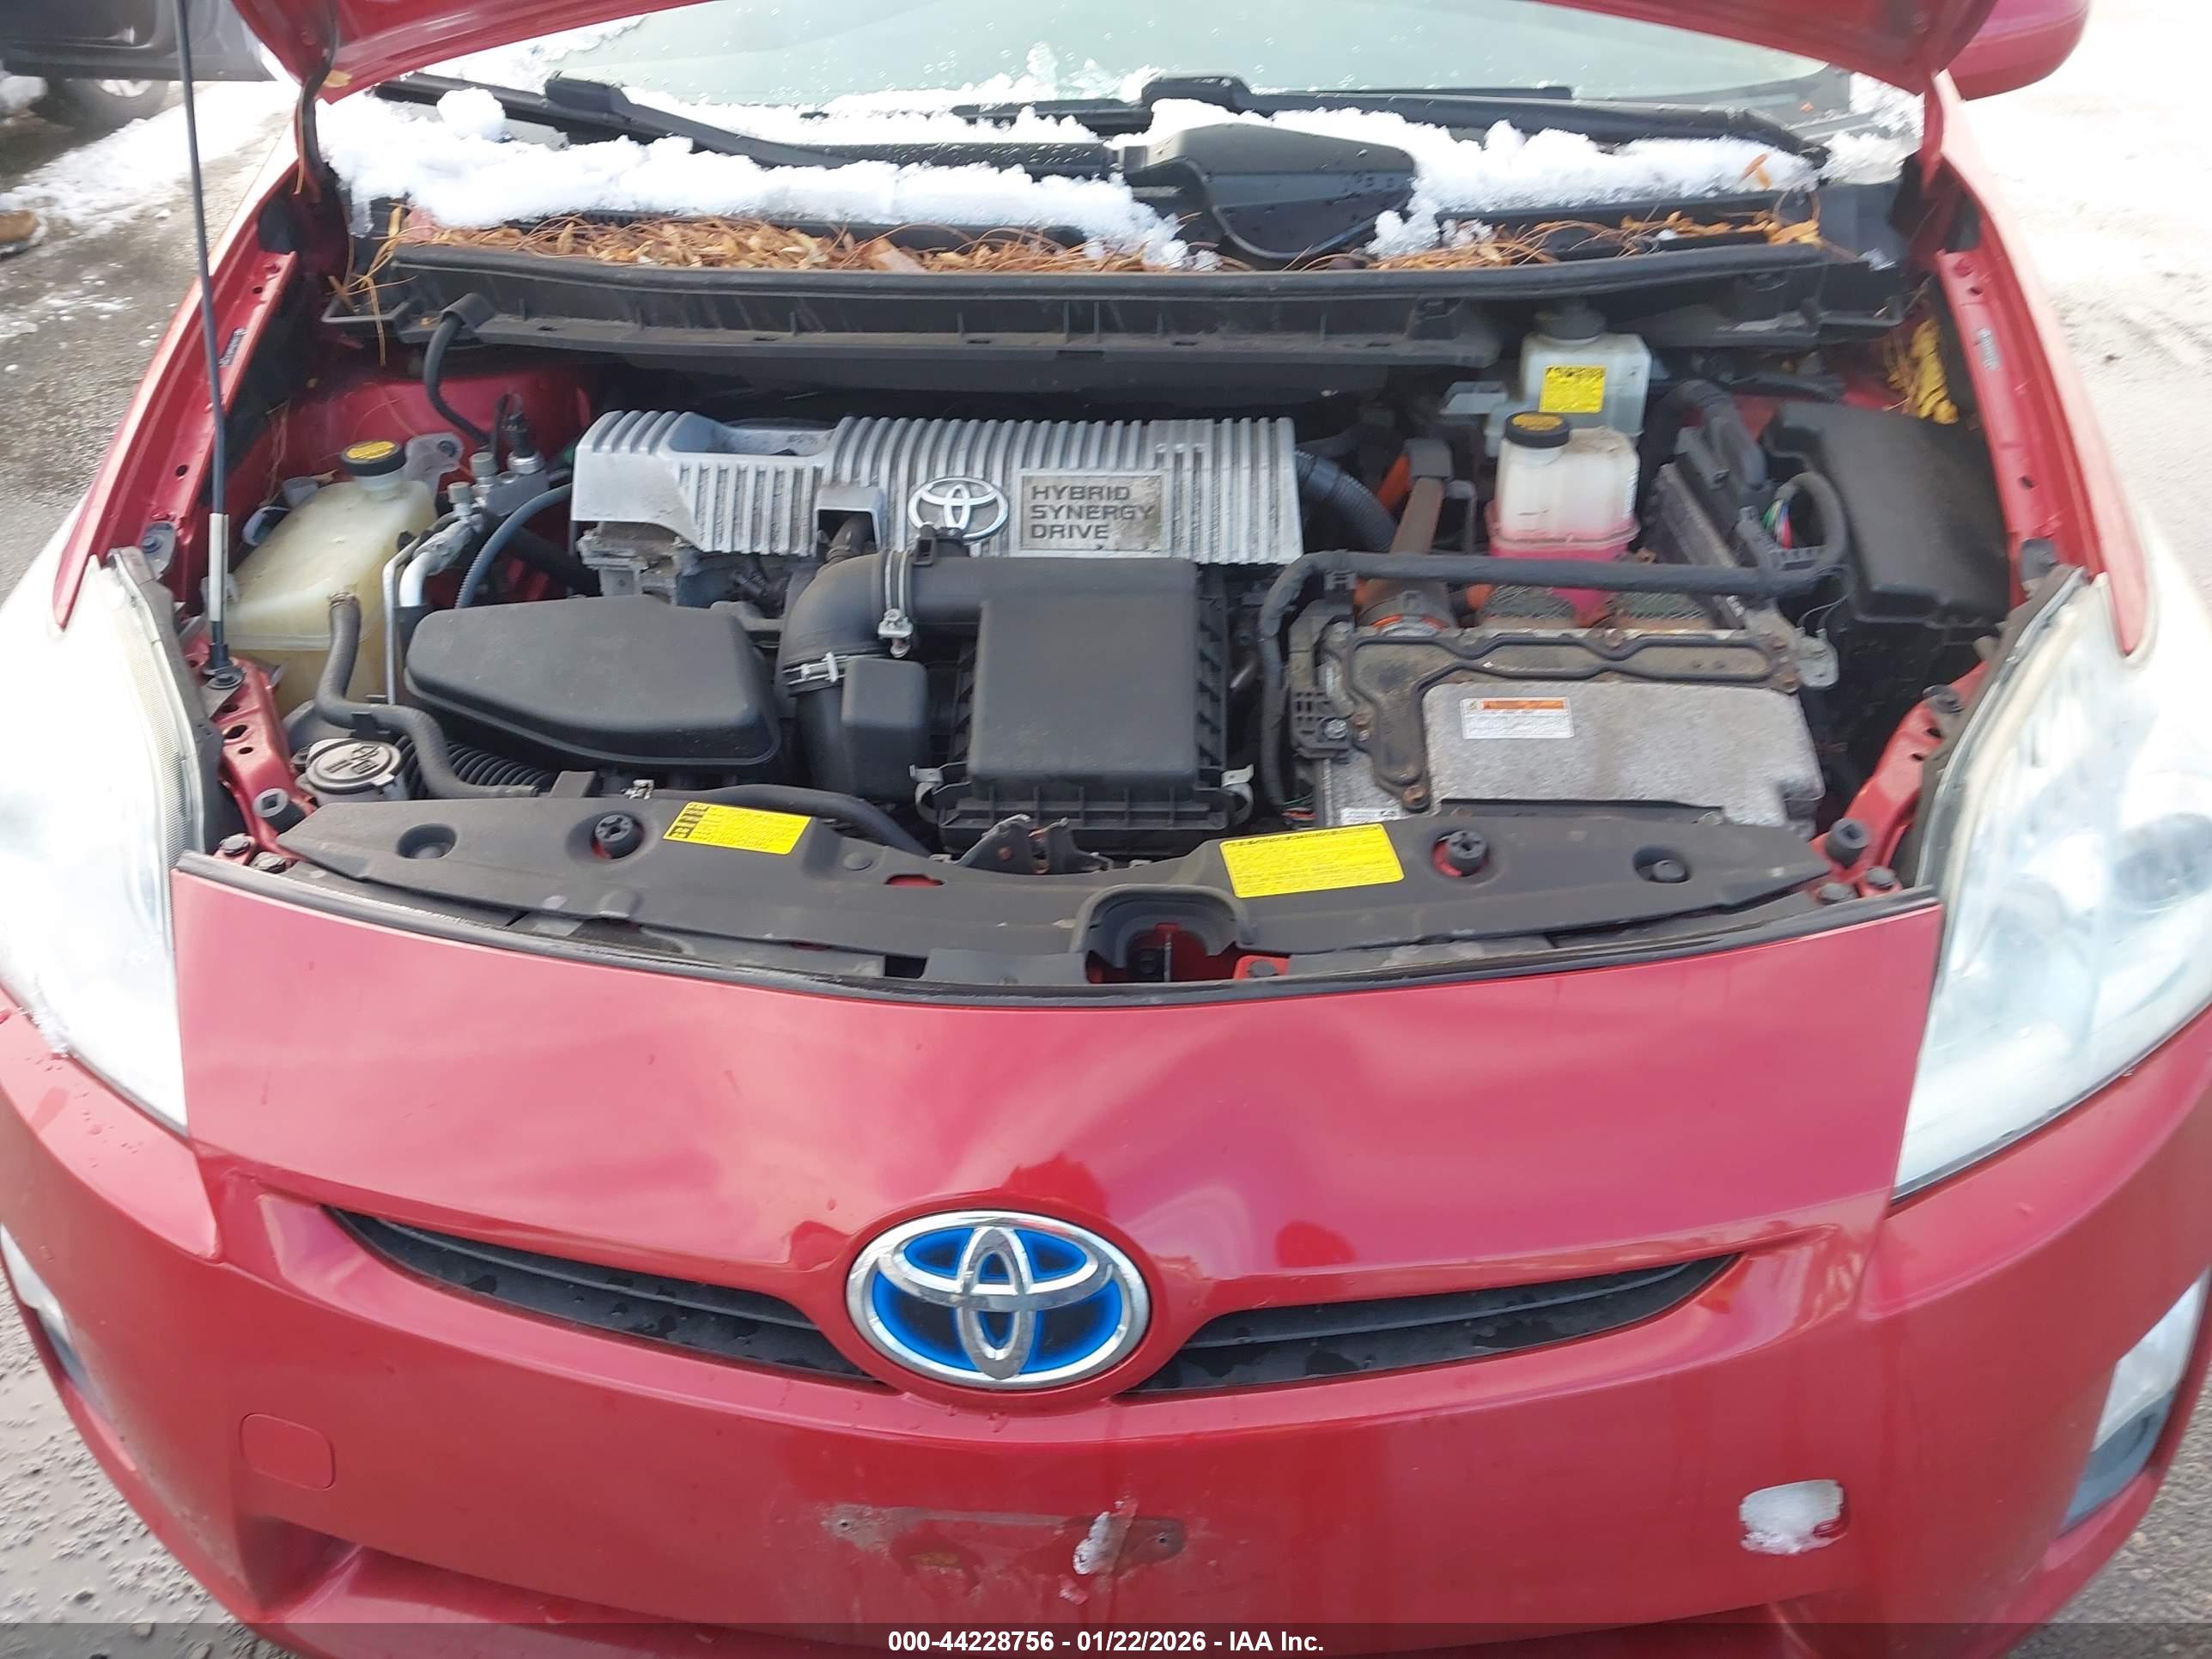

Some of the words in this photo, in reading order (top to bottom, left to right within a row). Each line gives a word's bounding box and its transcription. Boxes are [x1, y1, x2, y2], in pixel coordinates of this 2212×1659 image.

[1031, 485, 1131, 501] HYBRID
[1031, 504, 1155, 520] SYNERGY
[1031, 524, 1109, 539] DRIVE
